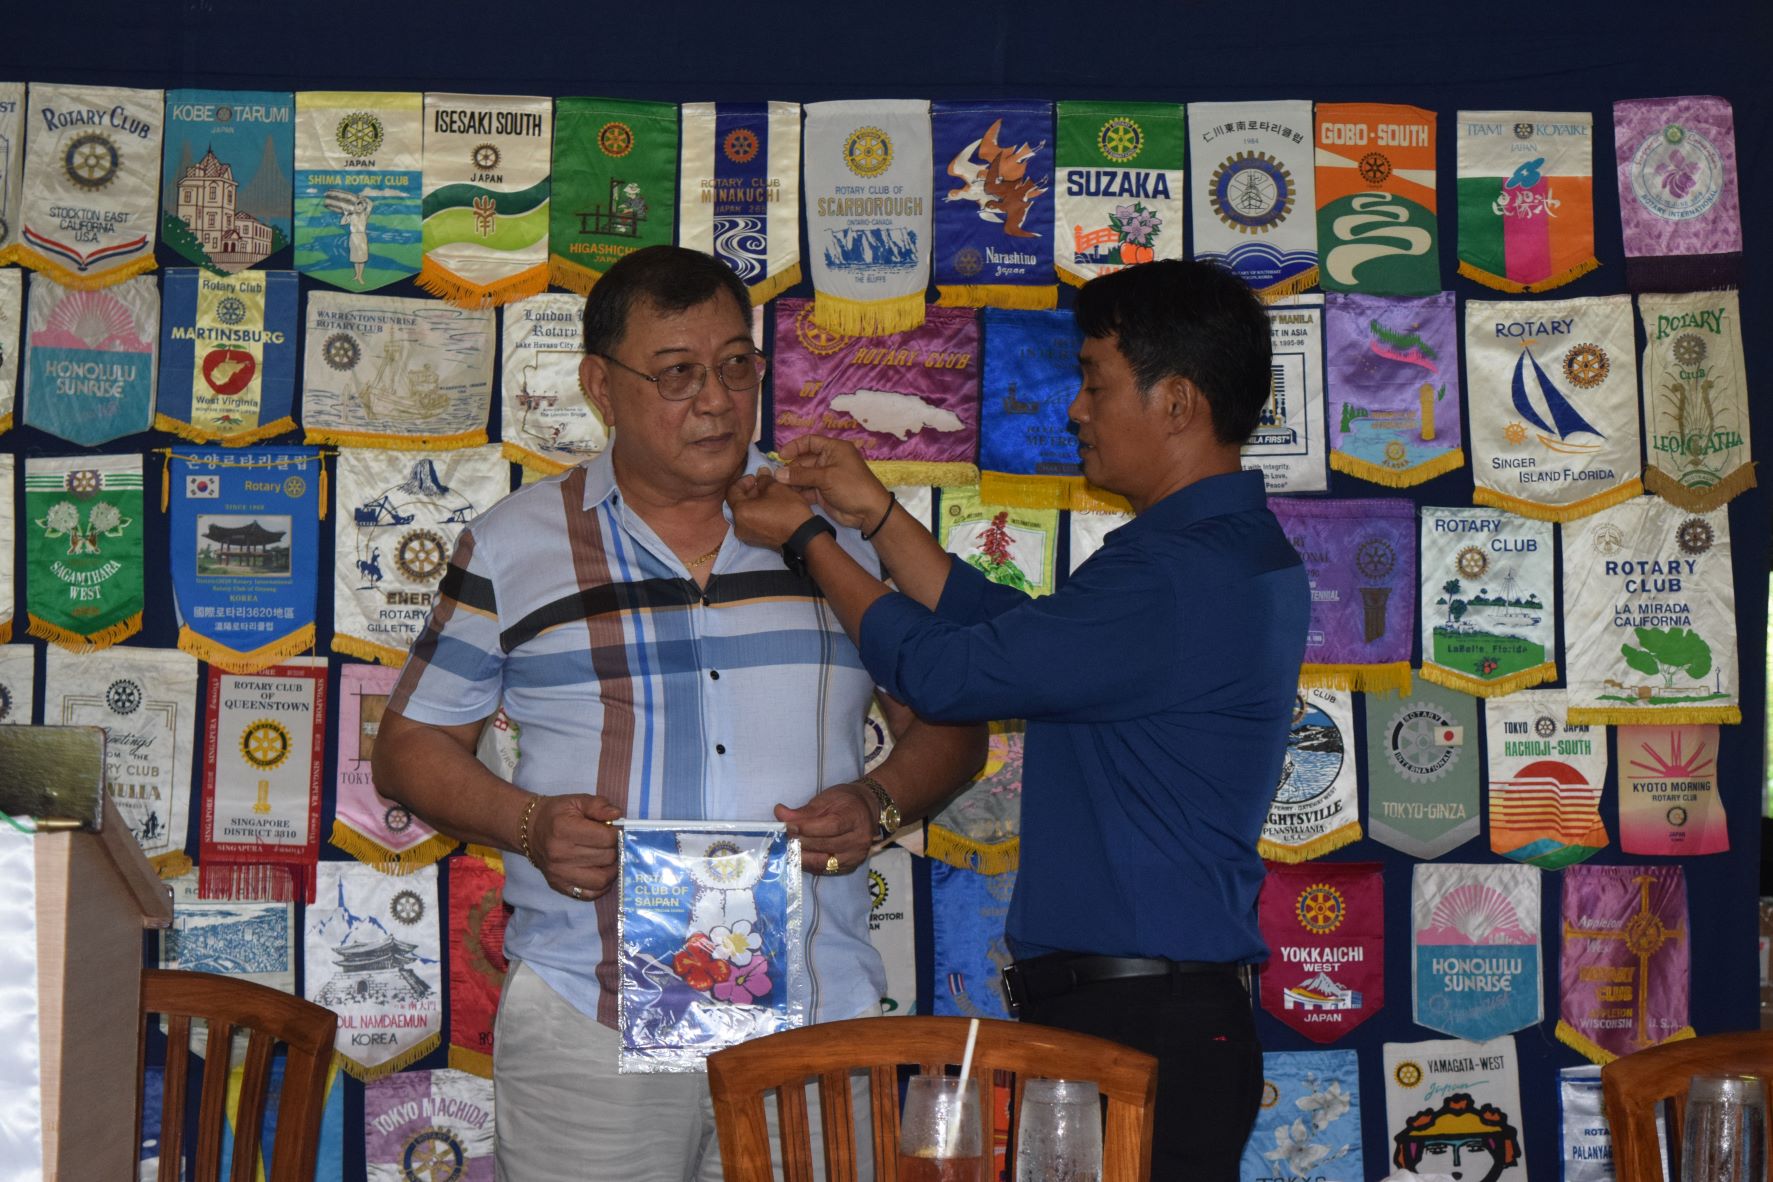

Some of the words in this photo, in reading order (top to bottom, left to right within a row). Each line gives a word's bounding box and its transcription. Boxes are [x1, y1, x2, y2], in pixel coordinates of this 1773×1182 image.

[172, 104, 215, 122] KOBE
[234, 105, 289, 123] TARUMI
[42, 107, 107, 131] ROTARY
[109, 105, 150, 139] CLUB
[435, 109, 493, 134] ISESAKI
[496, 111, 542, 137] SOUTH
[1467, 124, 1503, 136] ITAMI
[1536, 124, 1589, 136] KOYAIKE
[344, 159, 376, 168] JAPAN
[308, 175, 342, 186] SHIMA
[345, 175, 382, 186] ROTARY
[384, 175, 409, 186] CLUB
[470, 173, 503, 184] JAPAN
[701, 178, 743, 188] ROTARY
[752, 178, 781, 188] CLUB
[1066, 170, 1171, 199] SUZAKA
[701, 188, 780, 203] MINAKUCHI
[835, 186, 864, 195] ROTARY
[869, 186, 890, 195] CLUB
[893, 186, 904, 194] OF
[817, 197, 923, 217] SCARBOROUGH
[1641, 194, 1666, 214] ROTARY
[1669, 190, 1718, 217] INTERNATIONAL
[49, 206, 100, 222] STOCKTON
[103, 211, 130, 222] EAST
[59, 219, 115, 234] CALIFORNIA
[985, 247, 1037, 265] Narashino
[202, 279, 236, 293] Rotary
[239, 280, 262, 293] Club
[317, 310, 376, 323] WARRENTON
[377, 315, 417, 326] SUNRISE
[525, 309, 572, 321] London
[1278, 314, 1313, 325] MANILA
[316, 319, 355, 330] ROTARY
[356, 322, 383, 333] CLUB
[532, 325, 577, 337] Rotary
[1495, 319, 1574, 338] ROTARY
[1656, 308, 1725, 340] ROTARY
[171, 326, 285, 344] MARTINSBURG
[1281, 329, 1289, 337] IN
[1291, 329, 1308, 337] ASIA
[853, 348, 917, 366] ROTARY
[925, 352, 972, 369] CLUB
[45, 361, 136, 381] HONOLULU
[57, 378, 124, 398] SUNRISE
[223, 396, 258, 408] Virginia
[1492, 457, 1536, 469] SINGER
[1519, 471, 1561, 483] ISLAND
[1563, 468, 1615, 482] FLORIDA
[245, 480, 281, 493] Rotary
[1435, 519, 1500, 532] ROTARY
[1491, 538, 1538, 552] CLUB
[50, 559, 122, 585] SAGAMIHARA
[1605, 560, 1697, 576] ROTARY
[69, 586, 102, 600] WEST
[1625, 578, 1682, 594] CLUB
[229, 594, 258, 602] KOREA
[379, 609, 427, 620] ROTARY
[1615, 604, 1632, 615] LA
[1638, 603, 1690, 615] MIRADA
[1614, 615, 1692, 628] CALIFORNIA
[233, 681, 273, 691] ROTARY
[275, 683, 303, 692] CLUB
[260, 692, 274, 700] OF
[1313, 689, 1337, 704] CLUB
[224, 700, 310, 712] QUEENSTOWN
[1403, 711, 1442, 722] ROTARY
[1504, 721, 1528, 734] TOKYO
[1504, 739, 1592, 757] HACHIOJI-SOUTH
[1395, 749, 1453, 774] INTERNATIONAL
[126, 764, 160, 777] CLUB
[1633, 782, 1668, 793] KYOTO
[1670, 781, 1711, 792] MORNING
[1652, 794, 1681, 802] ROTARY
[1682, 794, 1697, 802] CLUB
[1265, 799, 1343, 825] GHTSVILLE
[1382, 802, 1467, 820] TOKYO-GINZA
[231, 818, 290, 829] SINGAPORE
[1263, 825, 1325, 835] PENNSYLVANIA
[223, 828, 272, 838] DISTRICT
[635, 885, 669, 896] CLUB
[671, 886, 689, 896] OF
[634, 897, 680, 907] SAIPAN
[1281, 946, 1364, 963] YOKKAICHI
[1303, 963, 1341, 972] WEST
[1432, 958, 1523, 976] HONOLULU
[1444, 974, 1512, 992] SUNRISE
[360, 1013, 428, 1029] NAMDAEMUN
[1304, 1013, 1342, 1022] JAPAN
[1580, 1018, 1633, 1029] WISCONSIN
[351, 1032, 398, 1046] KOREA
[1428, 1056, 1505, 1073] YAMAGATA-WEST
[371, 1101, 419, 1136] TOKYO
[422, 1097, 490, 1130] MACHIDA
